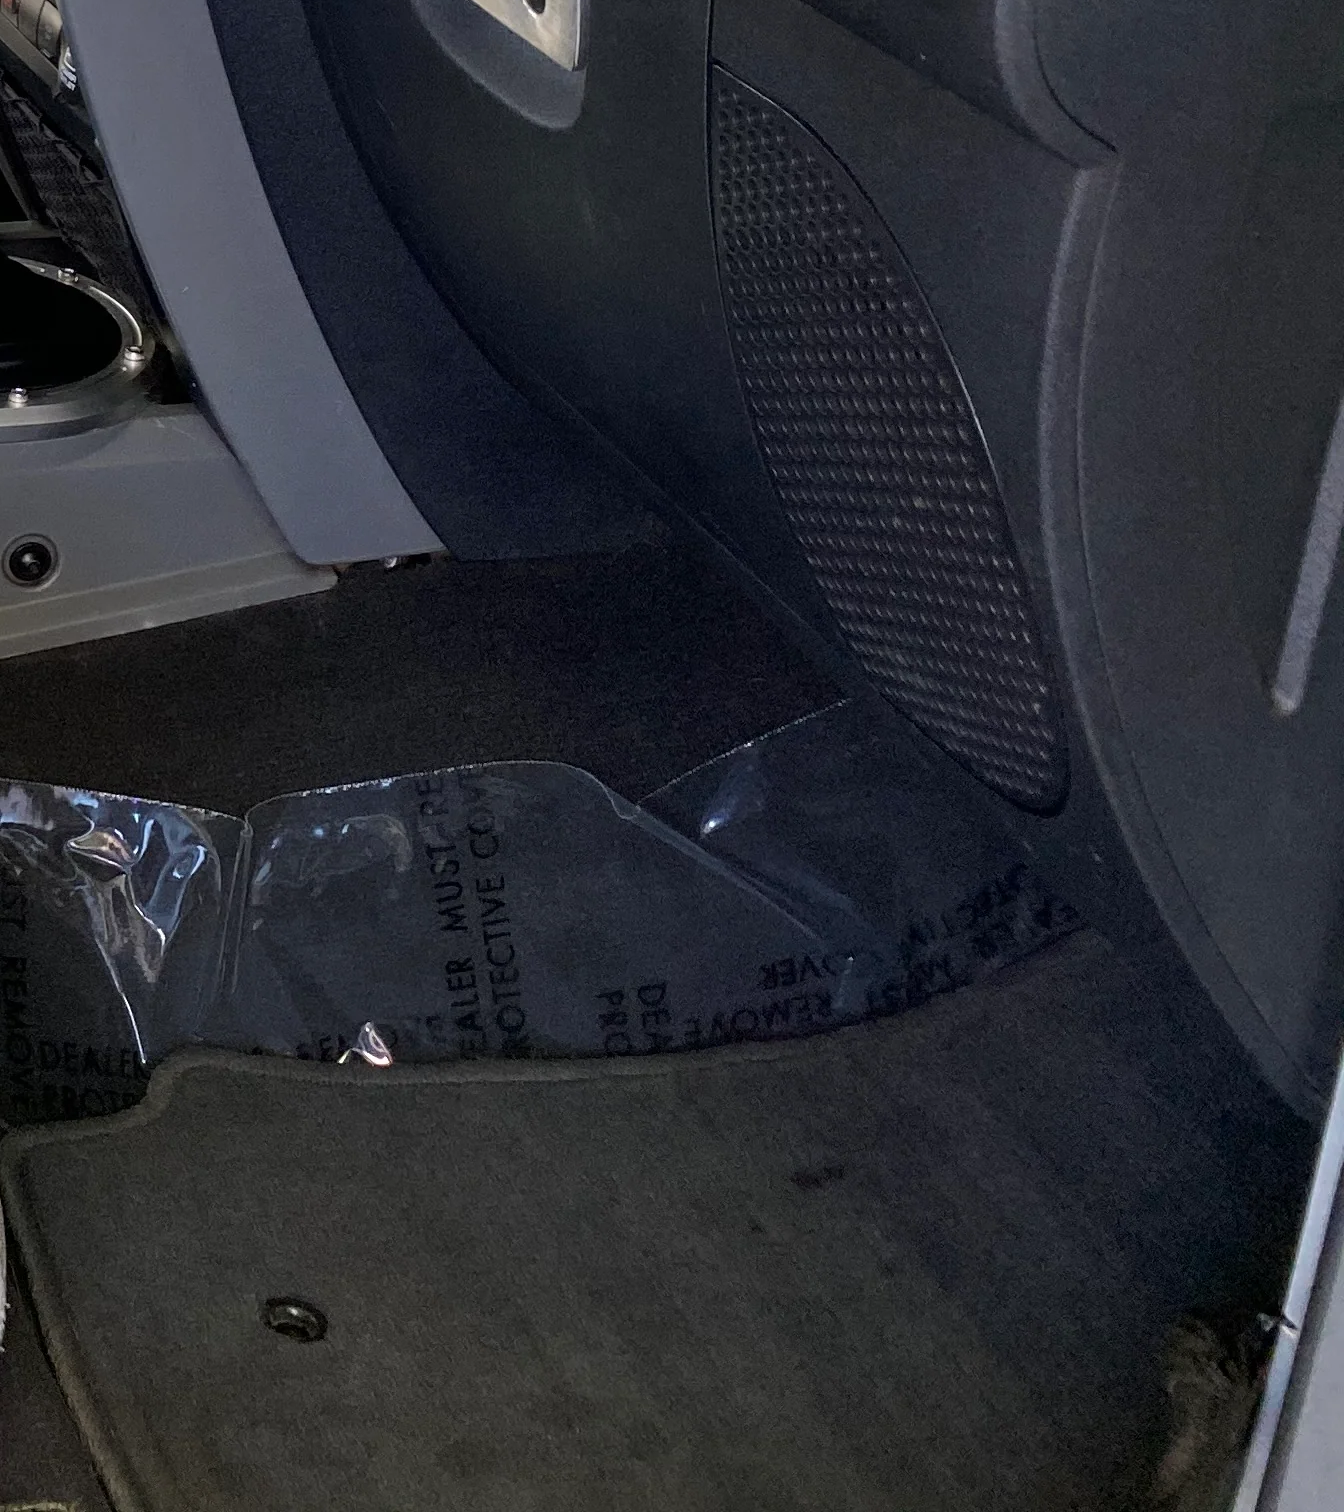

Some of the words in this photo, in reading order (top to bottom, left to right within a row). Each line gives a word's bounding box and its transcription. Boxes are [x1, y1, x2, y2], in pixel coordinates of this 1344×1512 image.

[425, 844, 469, 932] MUST
[444, 956, 487, 1060] EALER
[475, 874, 530, 1059] ROTECTIVE
